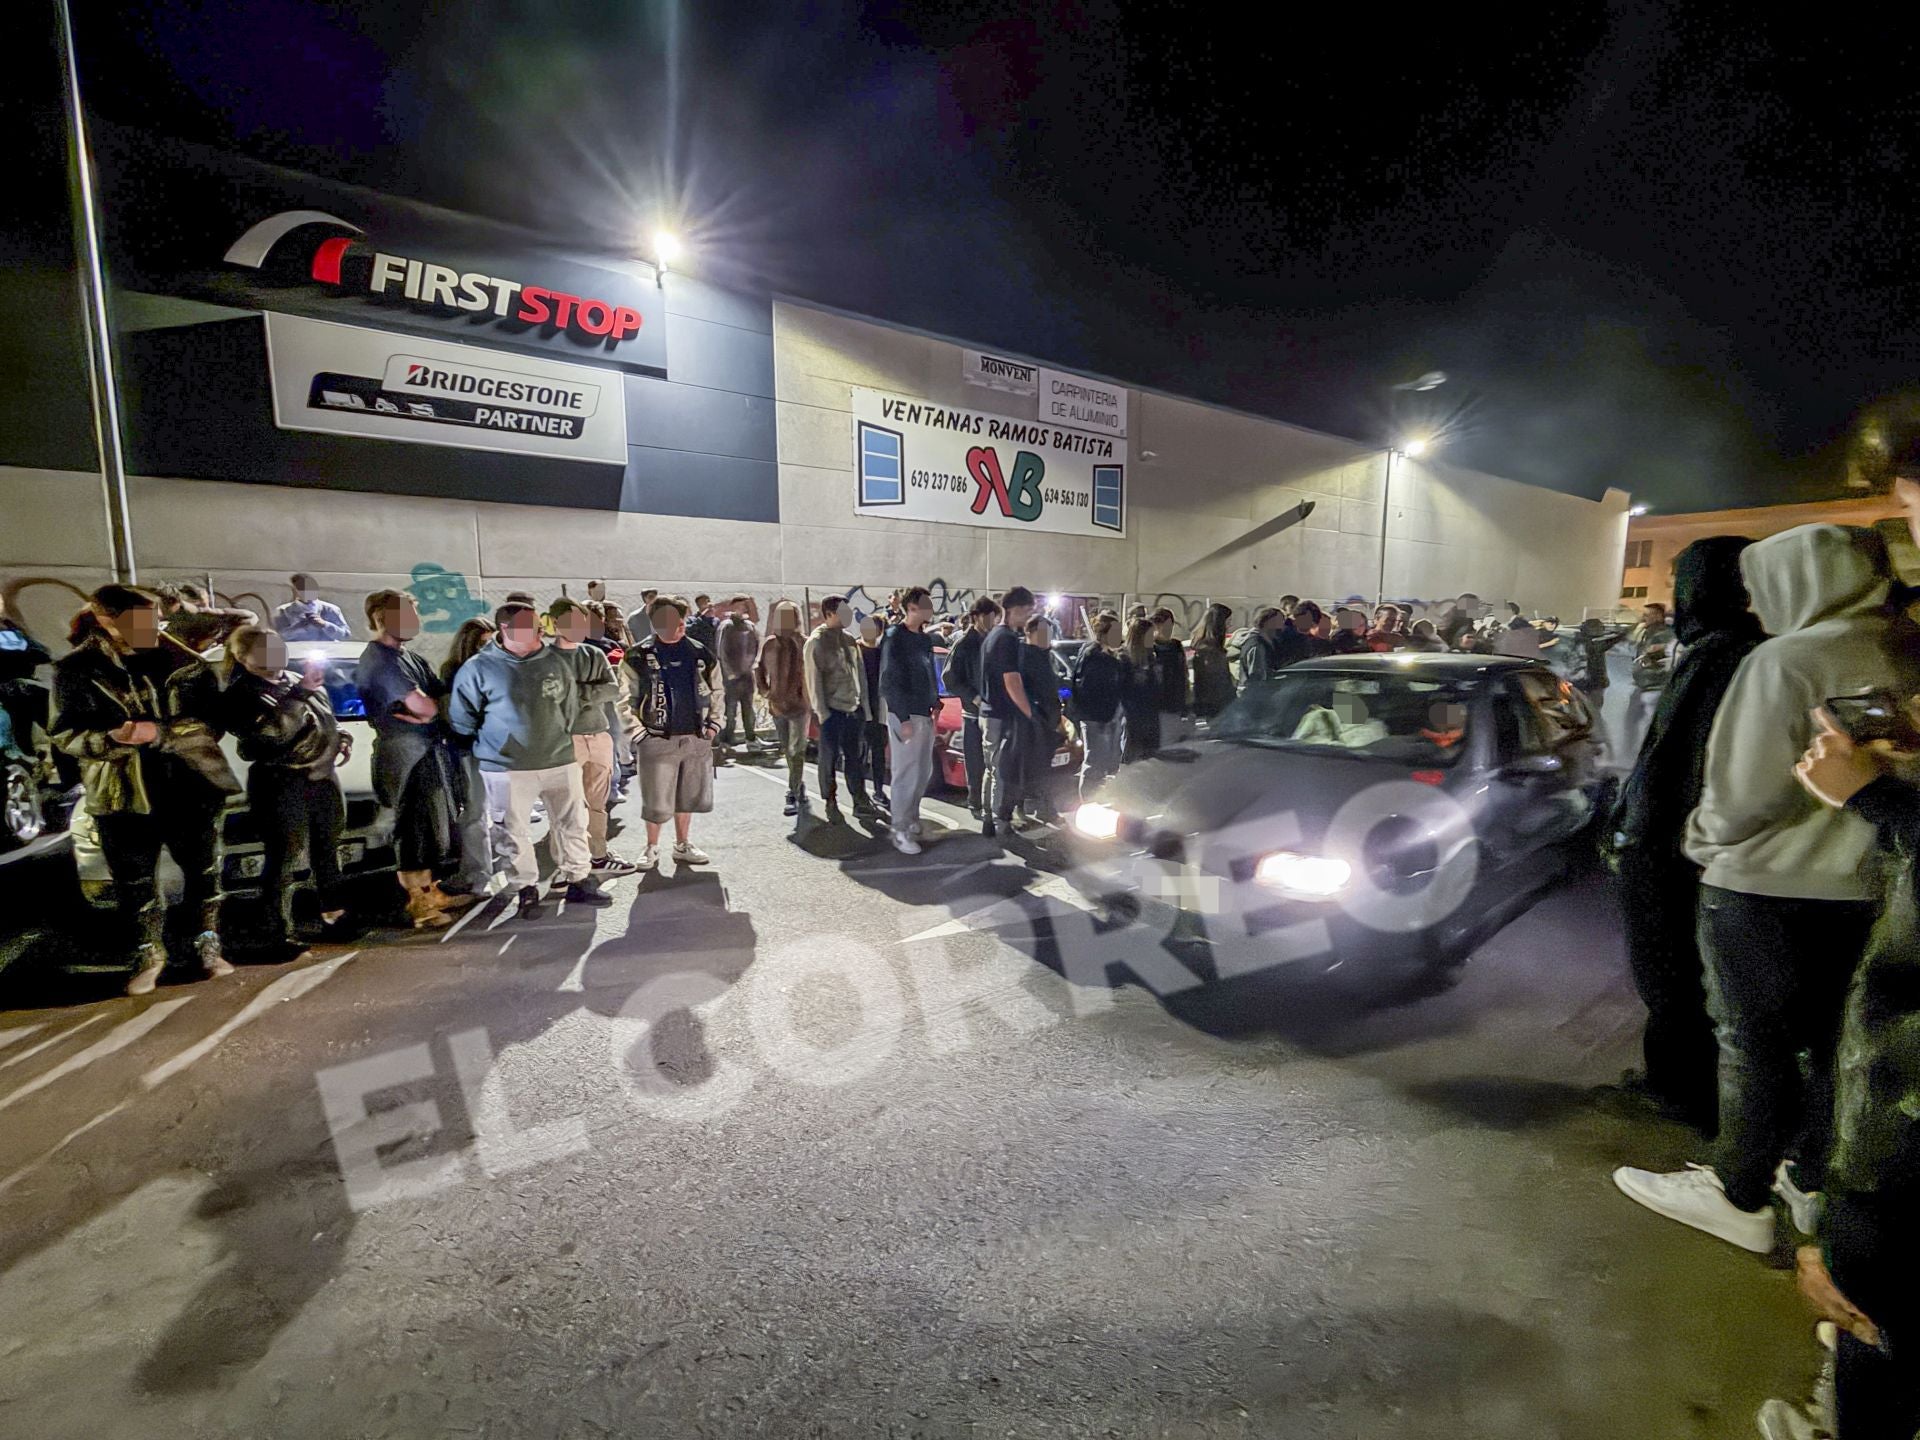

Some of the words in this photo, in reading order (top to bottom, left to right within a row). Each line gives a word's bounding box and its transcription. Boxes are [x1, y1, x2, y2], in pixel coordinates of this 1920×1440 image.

[404, 364, 584, 410] BRIDGESTONE
[474, 407, 574, 437] PARTNER
[882, 397, 983, 435] VENTANAS
[988, 419, 1050, 447] RAMOS
[1053, 432, 1113, 458] BATISTA
[1052, 401, 1067, 417] DE
[1069, 406, 1119, 428] ALUMINIO
[911, 469, 930, 488] 629
[931, 472, 948, 492] 237
[951, 475, 968, 493] 086
[1044, 488, 1060, 505] 634
[1061, 489, 1075, 506] 563
[1076, 491, 1089, 508] 130
